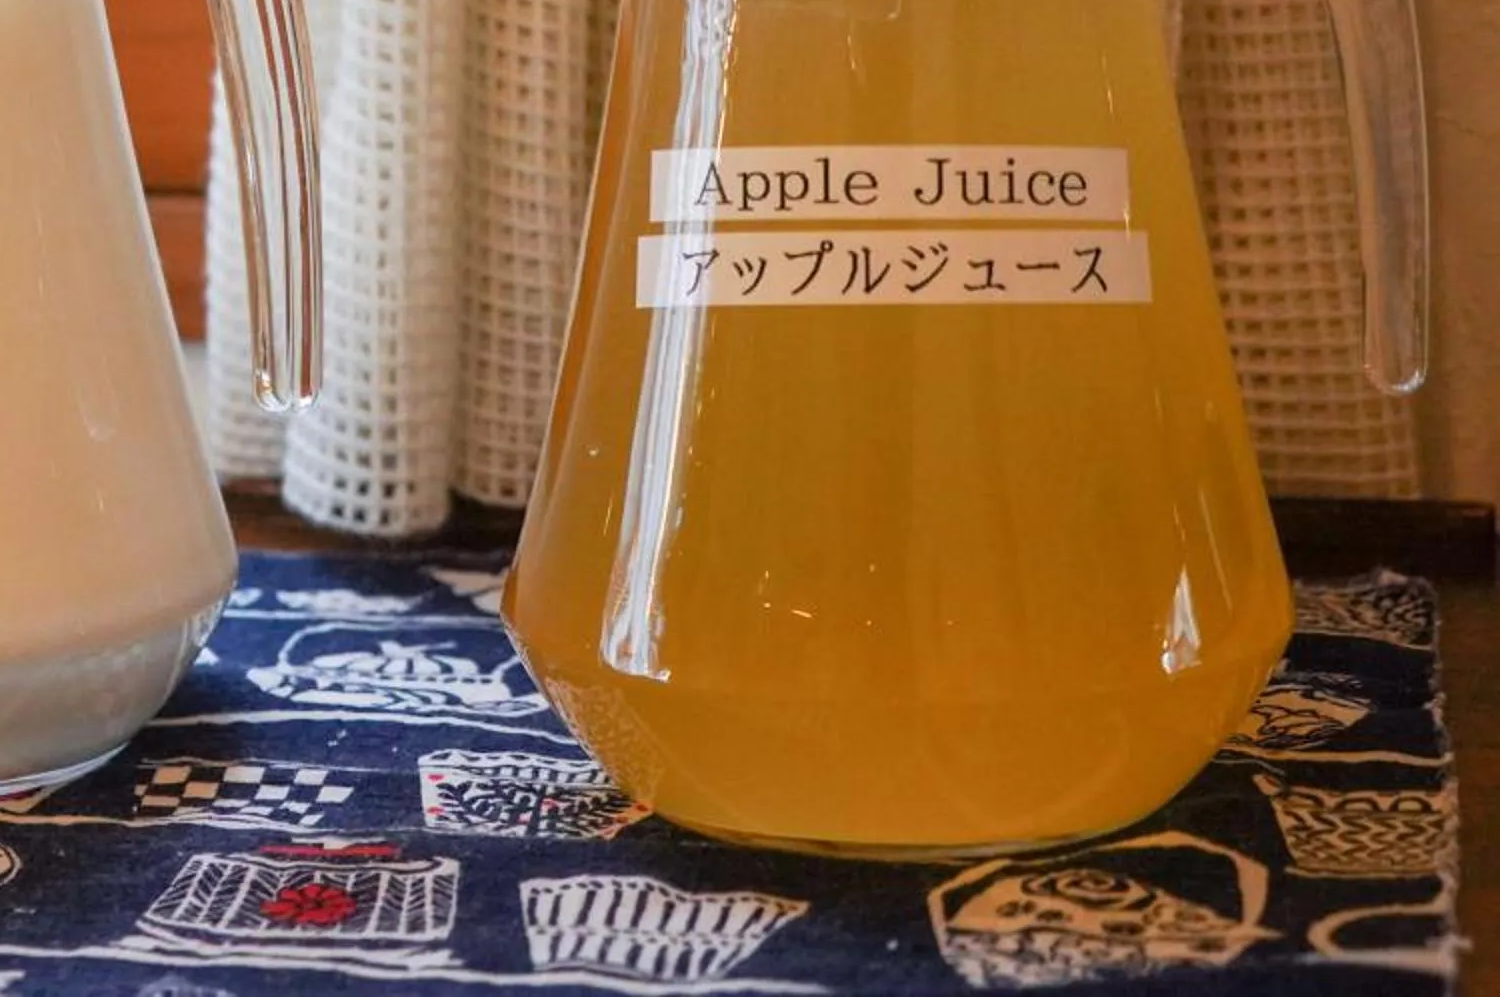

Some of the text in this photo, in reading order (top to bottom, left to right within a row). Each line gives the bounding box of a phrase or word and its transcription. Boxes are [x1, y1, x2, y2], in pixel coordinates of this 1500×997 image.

[694, 156, 1088, 212] Apple Juice
[681, 239, 1109, 296] アップルジュース
